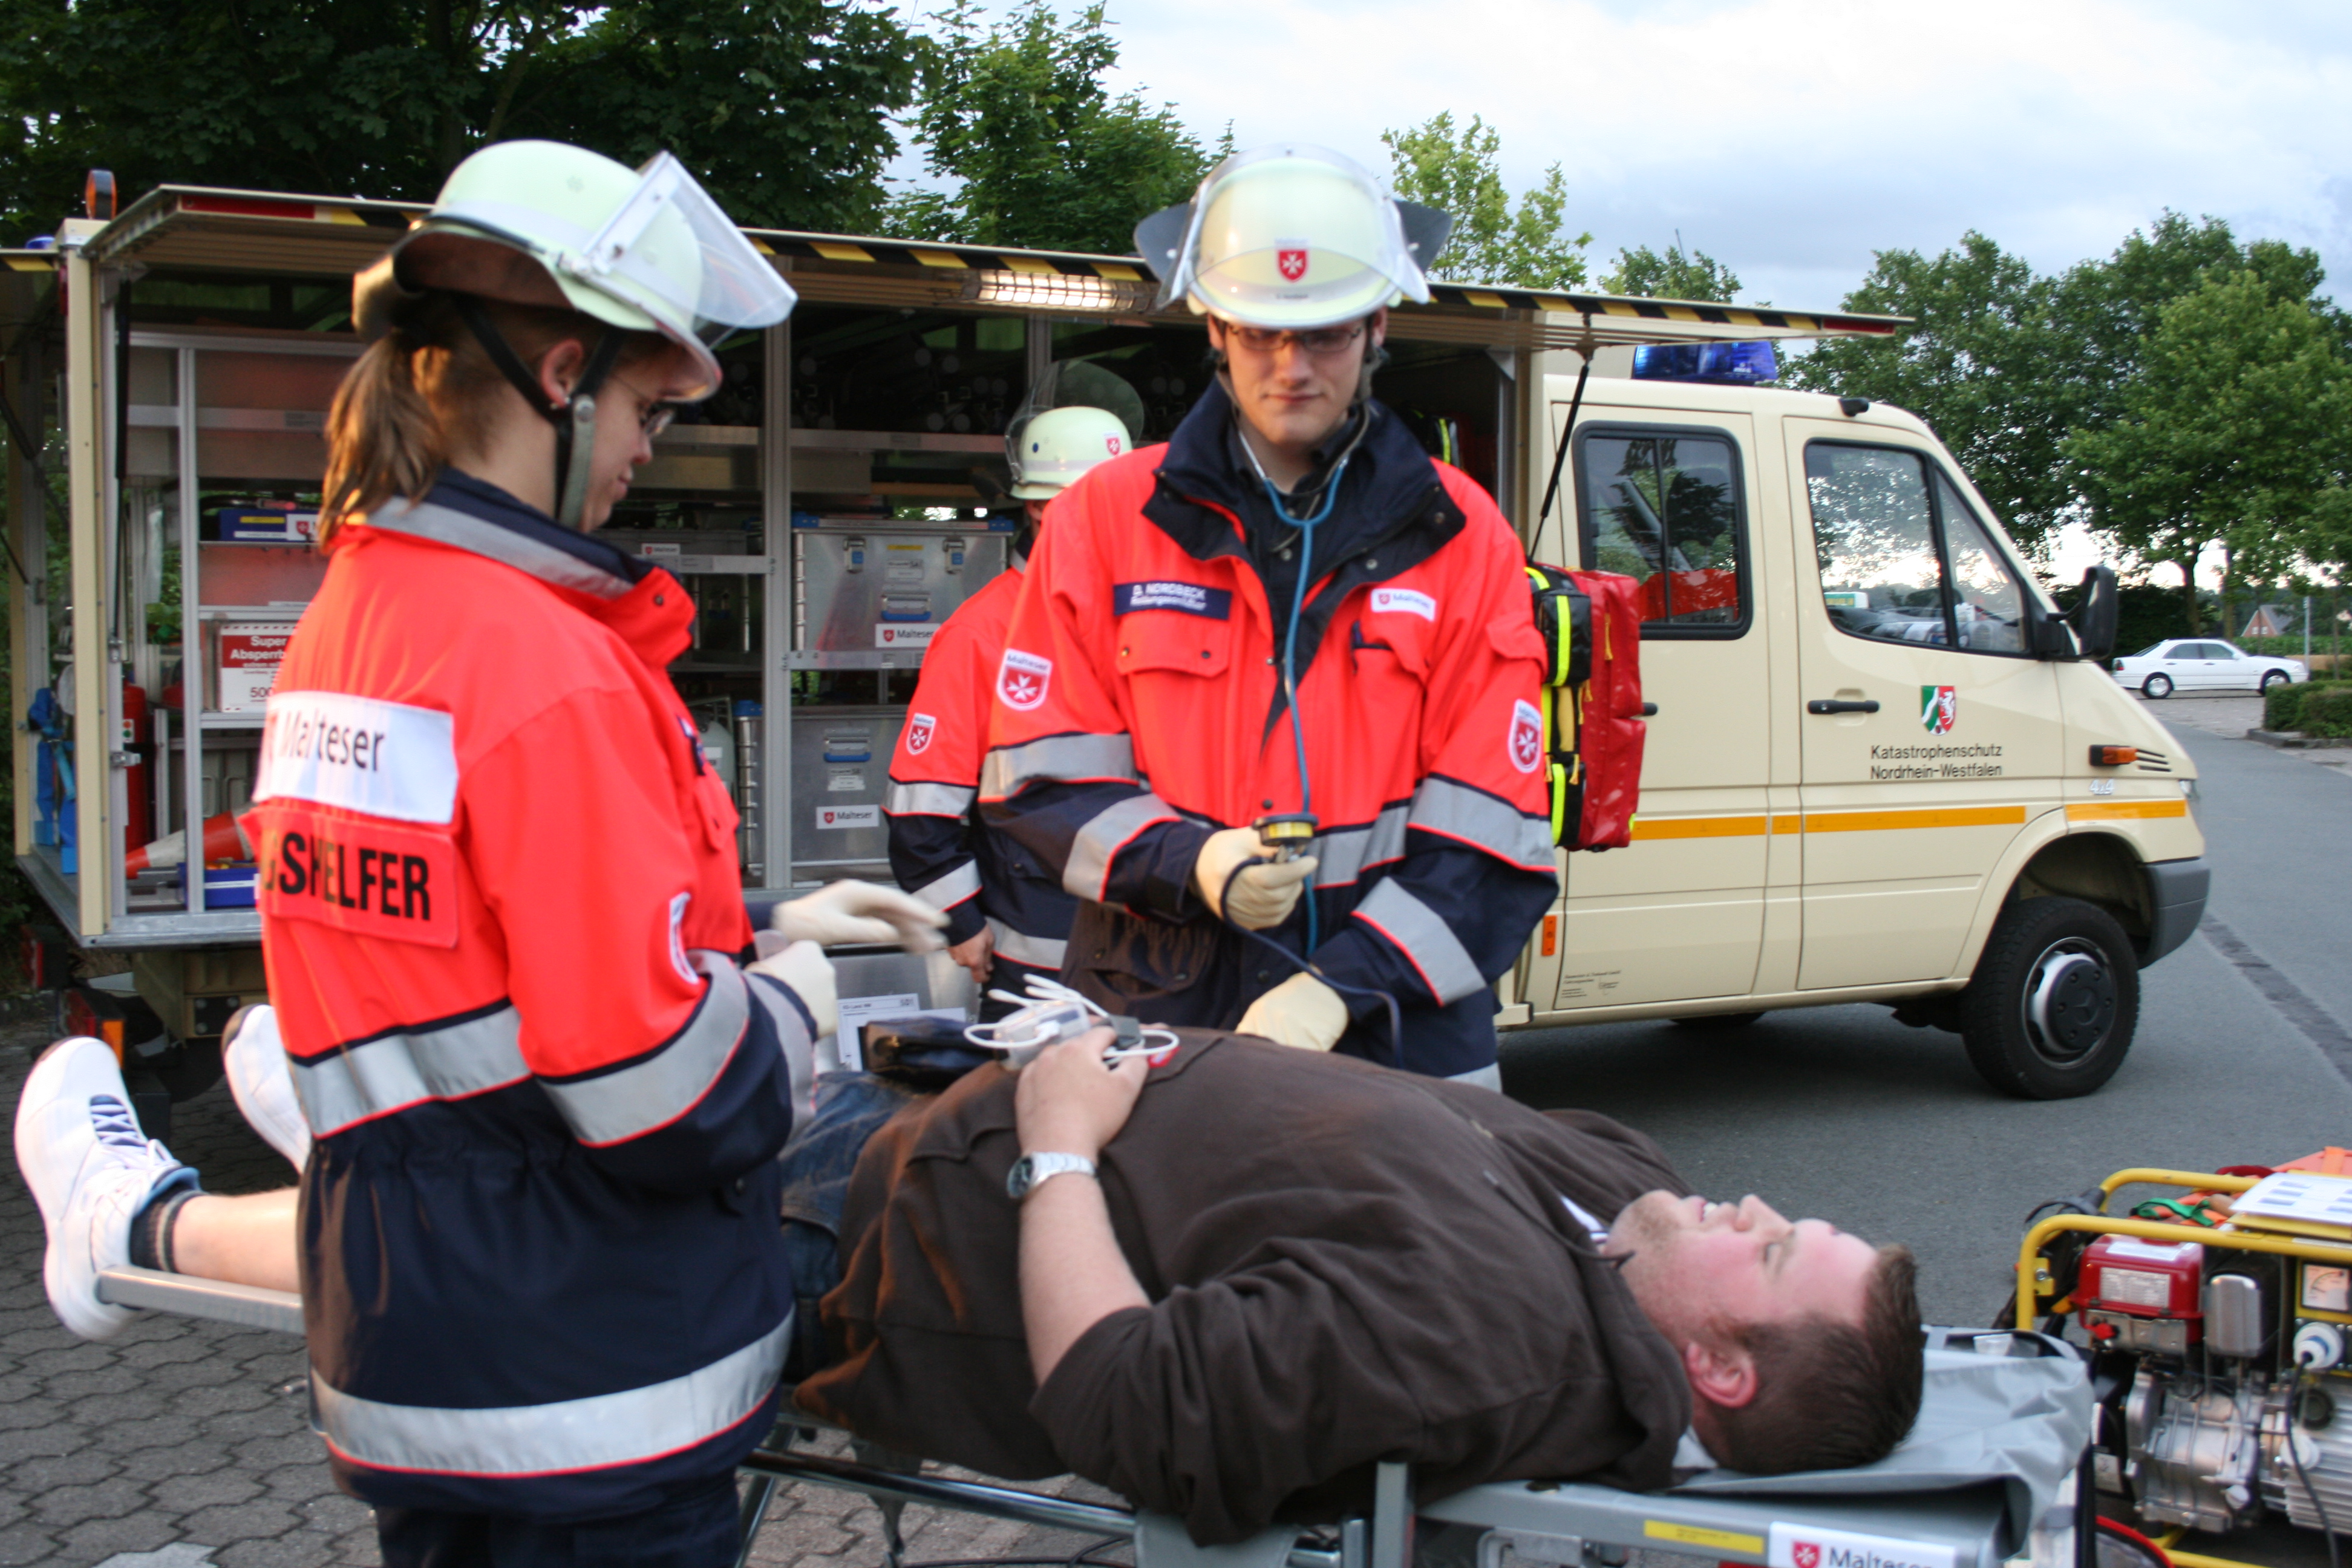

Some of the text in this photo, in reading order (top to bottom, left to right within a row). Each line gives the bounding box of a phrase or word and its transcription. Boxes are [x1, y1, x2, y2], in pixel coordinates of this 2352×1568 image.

[250, 635, 288, 648] Super
[279, 707, 384, 772] Malteser
[1870, 743, 2002, 760] Katastrophenschutz
[1870, 762, 2002, 780] Nordrhein-Westfalen
